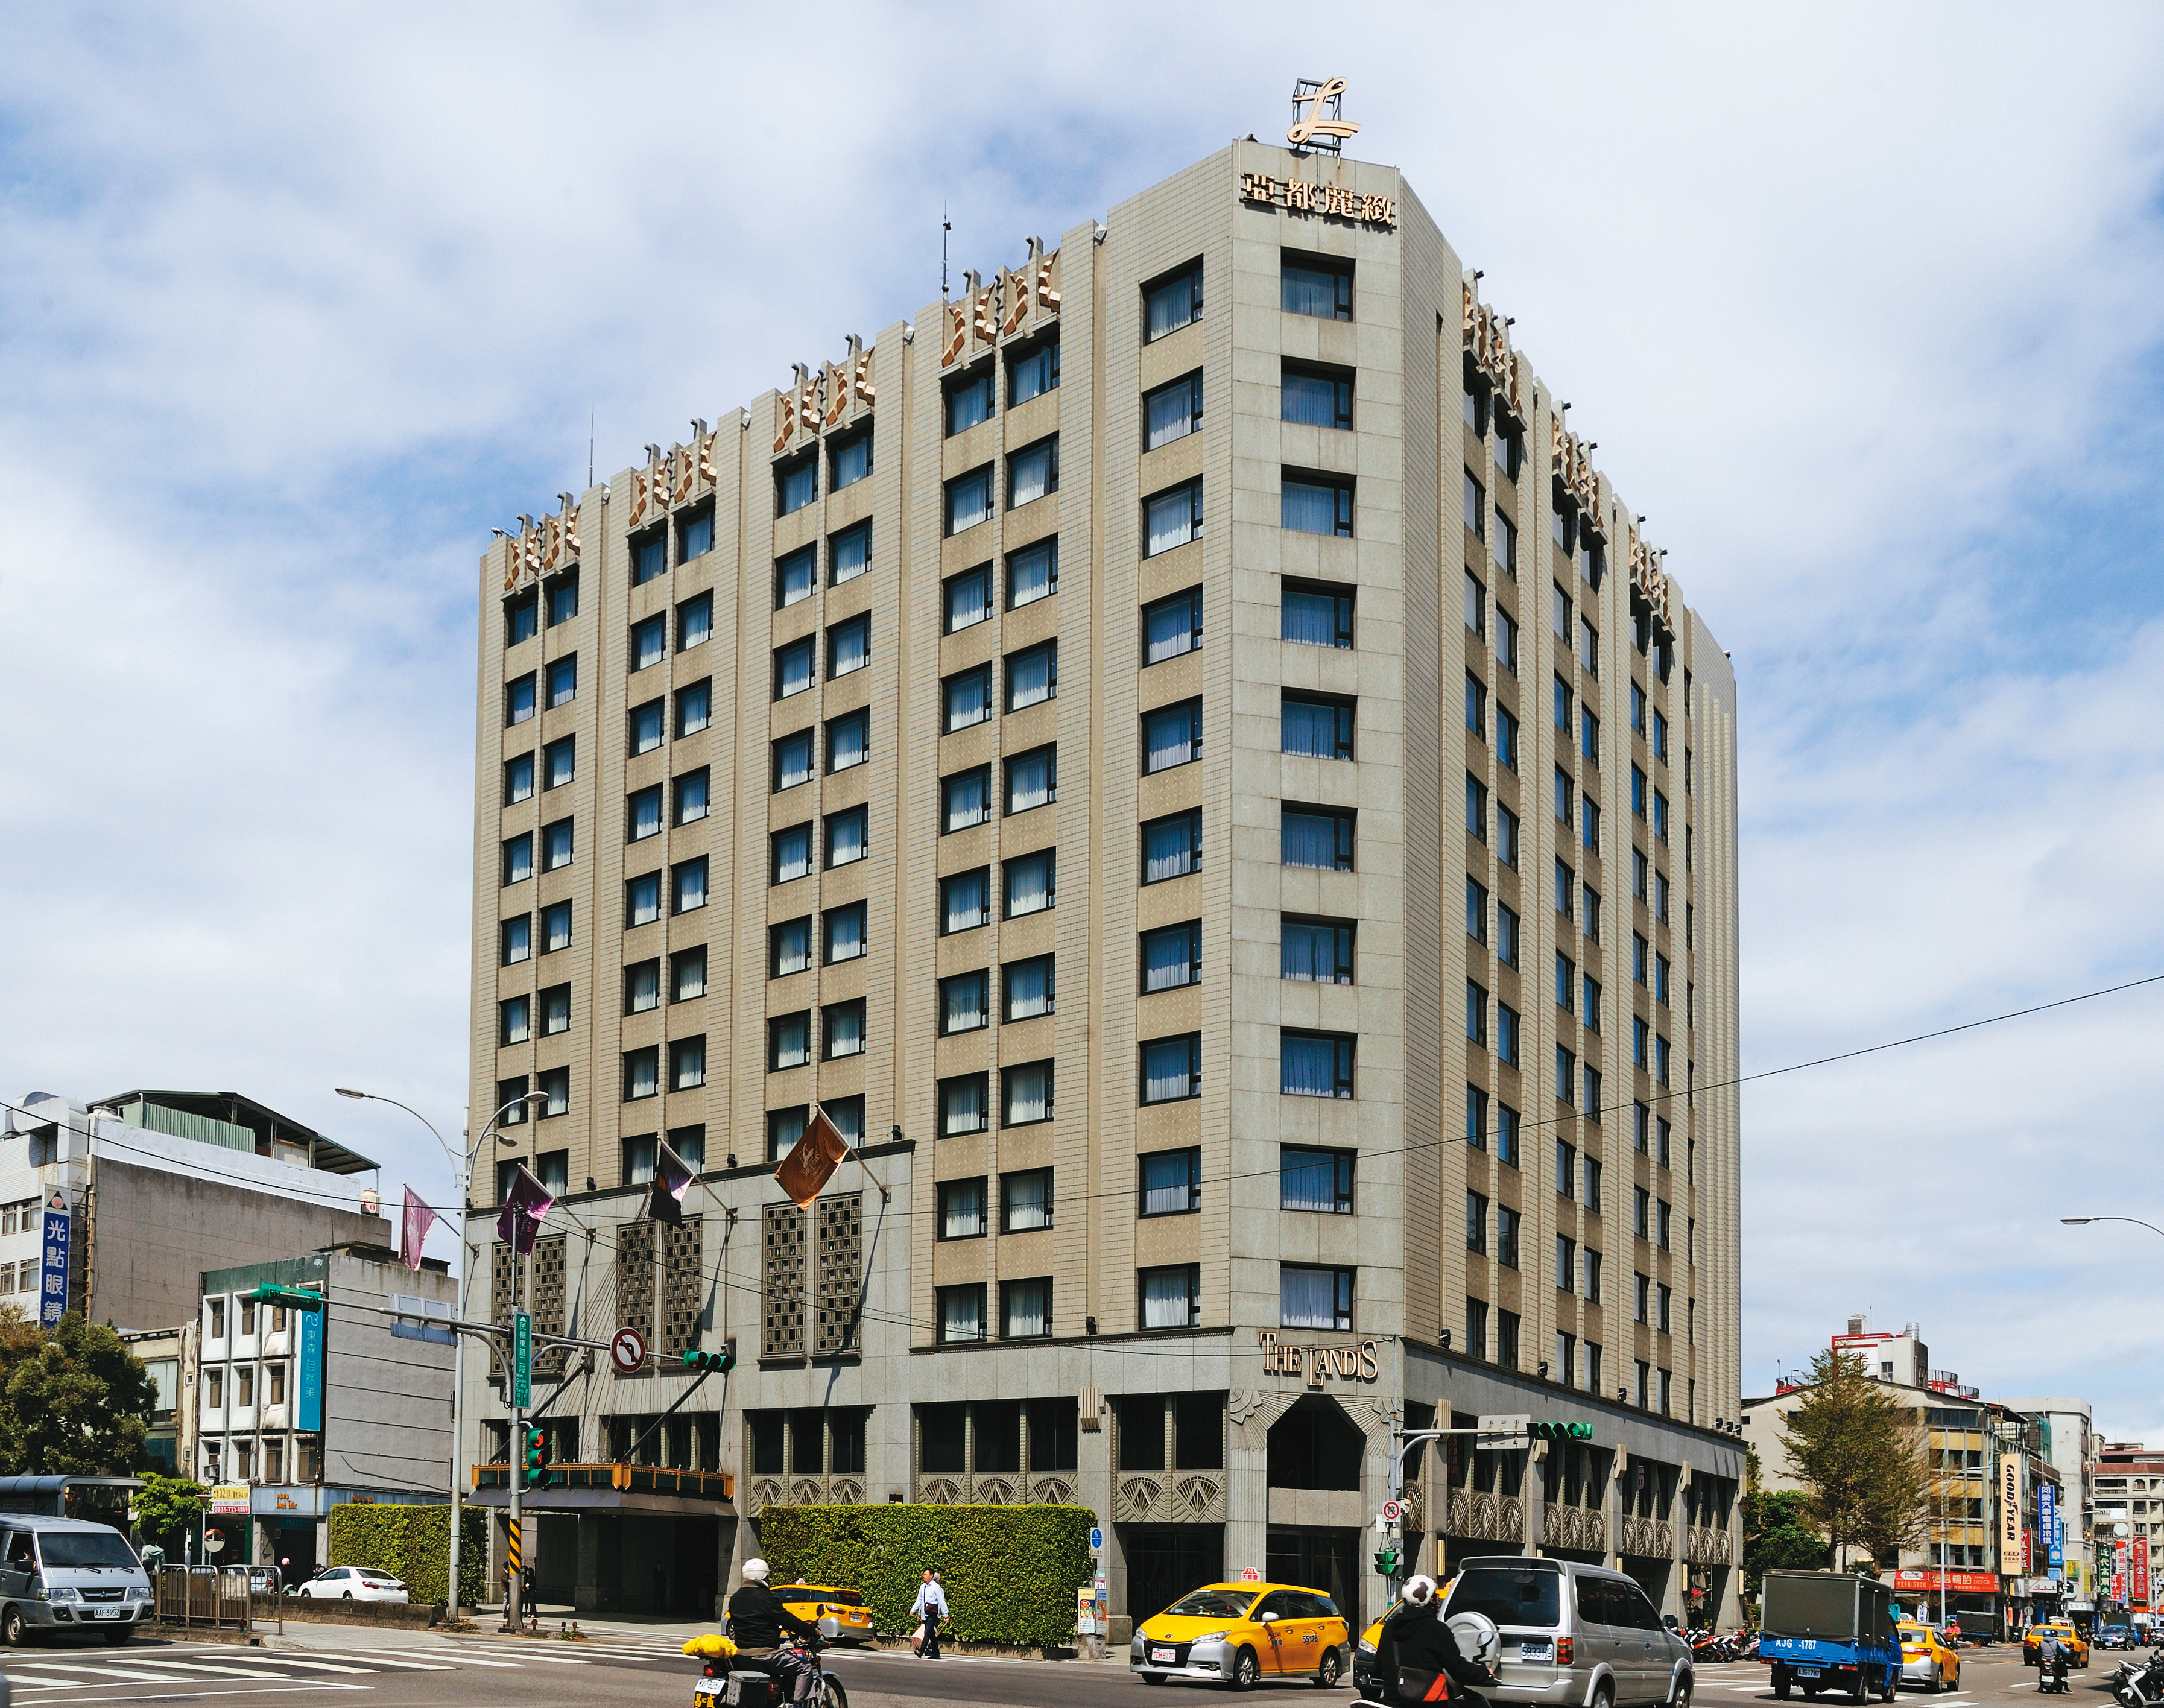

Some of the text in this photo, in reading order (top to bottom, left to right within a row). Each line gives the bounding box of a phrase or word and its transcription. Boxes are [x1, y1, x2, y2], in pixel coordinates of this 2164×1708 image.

[1244, 172, 1393, 225] 亞都麗緻
[44, 1219, 66, 1321] 光點眼鏡
[1259, 1332, 1379, 1386] THE LANDIS
[2005, 1464, 2017, 1542] GOODYEAR
[2100, 1548, 2110, 1596] 近代高爾夫
[1776, 1638, 1792, 1648] AJG
